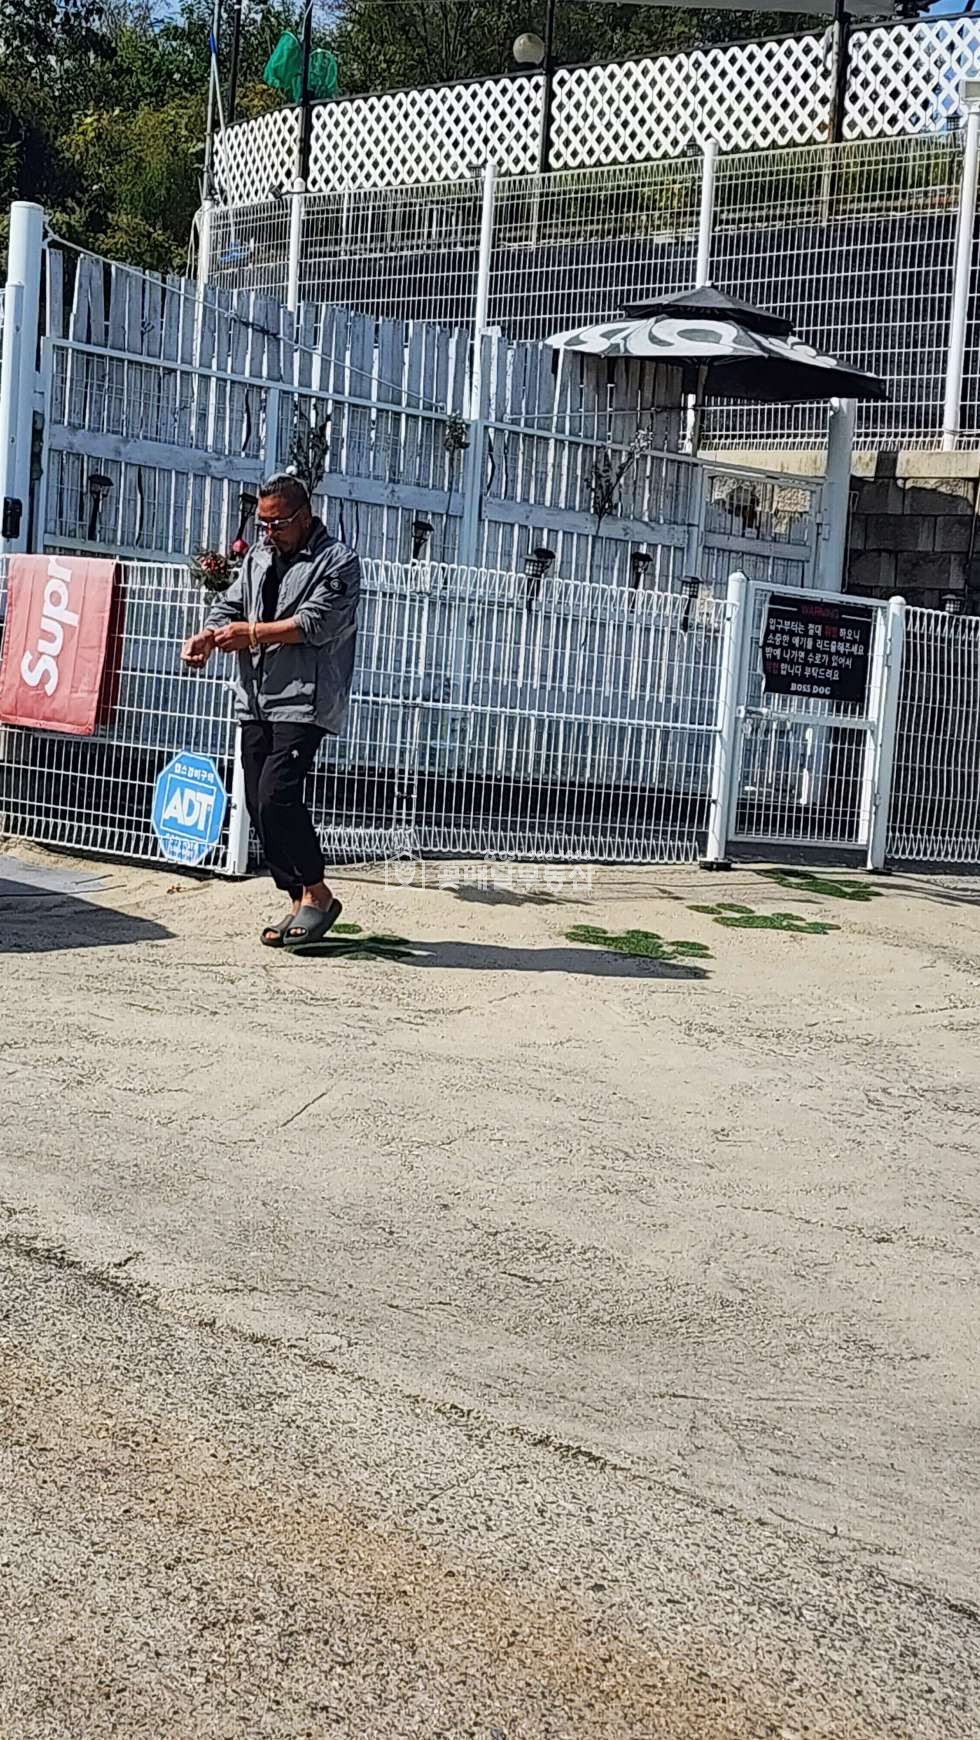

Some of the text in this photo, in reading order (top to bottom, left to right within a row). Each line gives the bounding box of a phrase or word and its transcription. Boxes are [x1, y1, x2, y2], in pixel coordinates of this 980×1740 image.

[769, 618, 805, 634] 입구부터는
[807, 623, 822, 636] 절대
[767, 633, 789, 646] 소중한
[765, 646, 781, 660] 밖에
[783, 649, 805, 663] 나가면
[807, 652, 829, 666] 수로가
[804, 666, 840, 680] 부탁드려요
[790, 682, 831, 695] BOSS DOG
[163, 787, 213, 831] ADT
